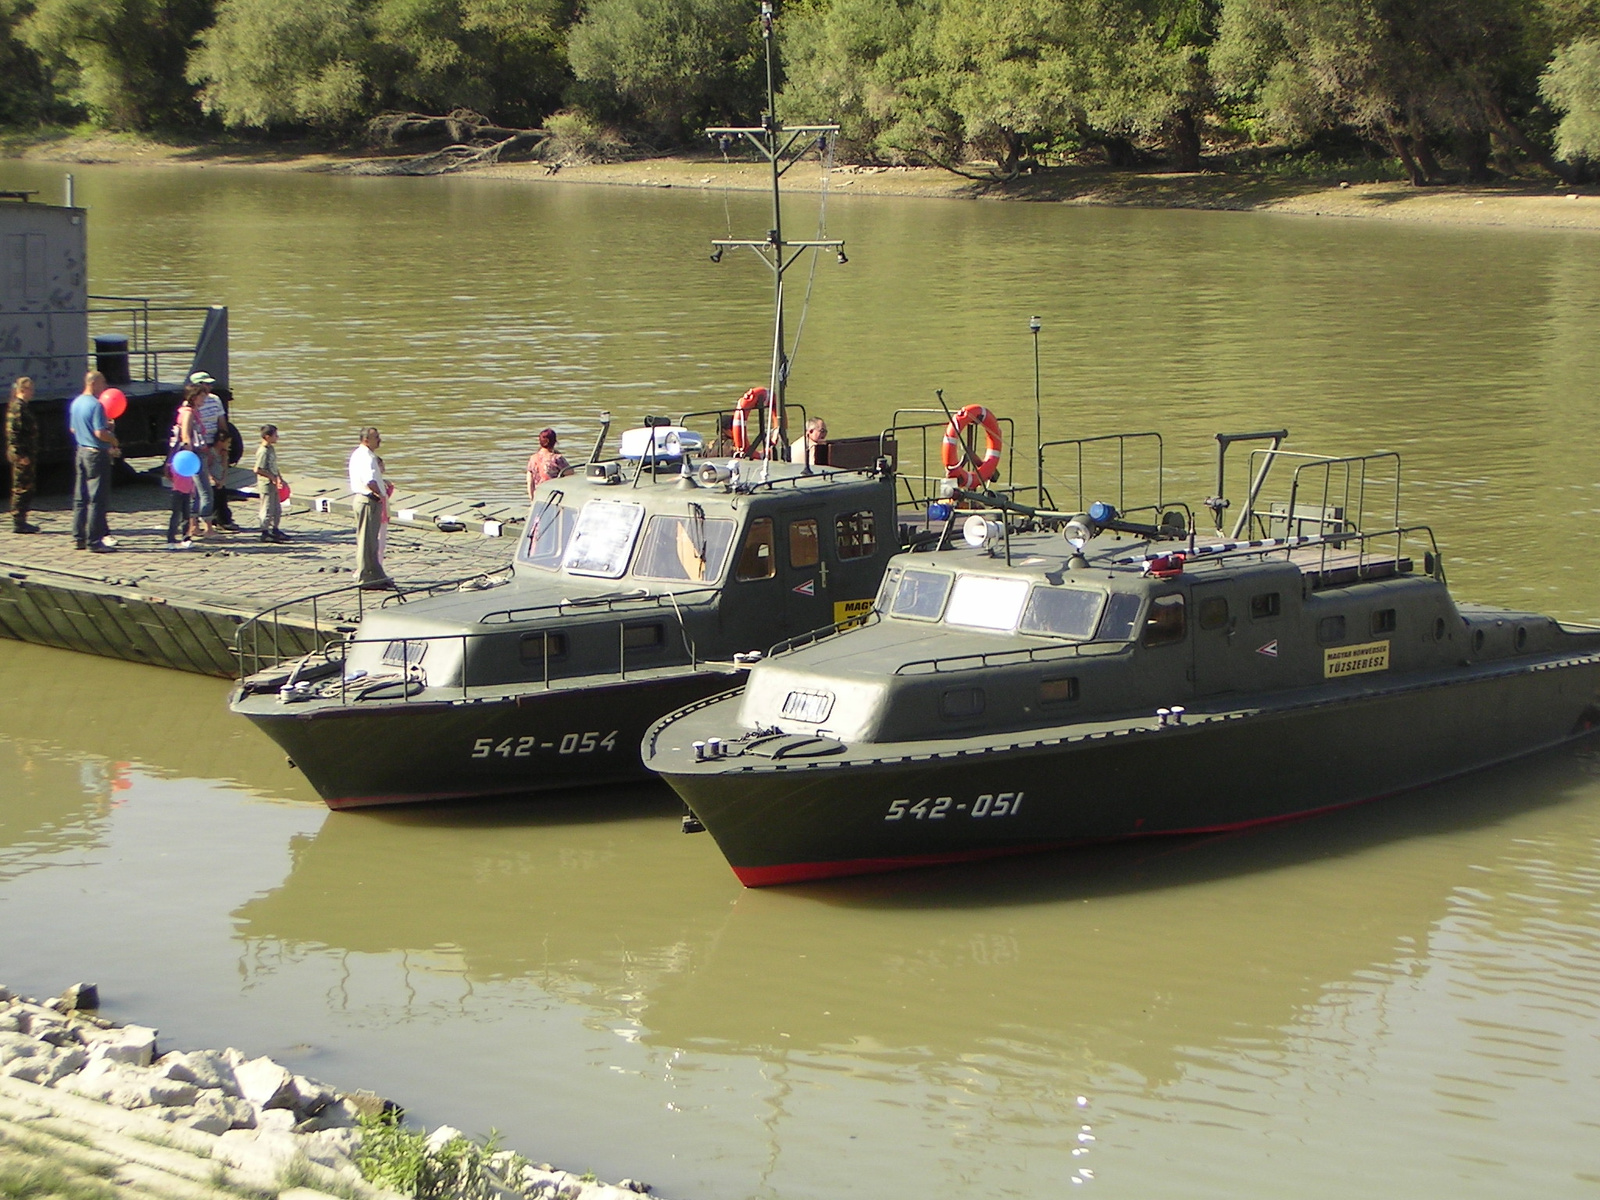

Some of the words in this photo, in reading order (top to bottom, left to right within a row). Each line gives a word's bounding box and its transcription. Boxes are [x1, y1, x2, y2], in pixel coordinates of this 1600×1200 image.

[1327, 651, 1352, 660] MAGYAR
[471, 730, 619, 758] 542-054
[884, 791, 1025, 820] 542-051
